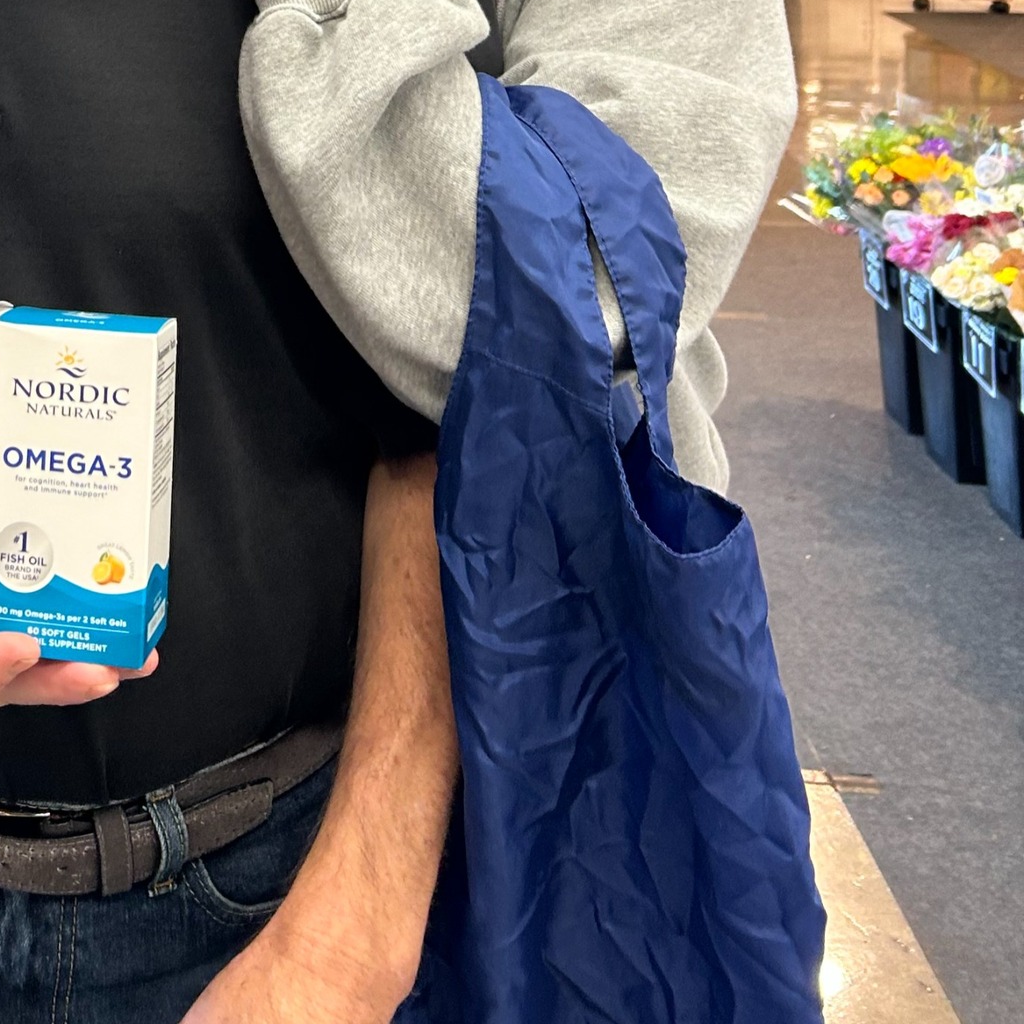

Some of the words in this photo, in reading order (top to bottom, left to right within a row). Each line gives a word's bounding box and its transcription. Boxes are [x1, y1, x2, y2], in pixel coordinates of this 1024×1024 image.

[12, 377, 130, 406] NORDIC
[3, 446, 133, 479] OMEGA-3
[15, 475, 26, 483] for
[28, 477, 68, 488] cognition,
[70, 480, 91, 489] heart
[93, 482, 118, 492] health
[41, 485, 71, 495] immune
[13, 531, 29, 554] #1
[0, 553, 25, 564] FISH
[29, 555, 47, 567] OIL
[4, 564, 32, 573] BRAND
[33, 567, 42, 575] IN
[6, 571, 21, 580] THE
[10, 608, 23, 617] mg
[24, 609, 65, 621] Omega-3s
[67, 614, 81, 624] per
[82, 615, 88, 624] 2
[90, 616, 107, 626] Soft
[109, 618, 127, 628] Gels
[27, 626, 40, 636] 60
[41, 627, 65, 638] SOFT
[66, 631, 90, 641] GELS
[49, 638, 108, 653] SUPPLEMENT
